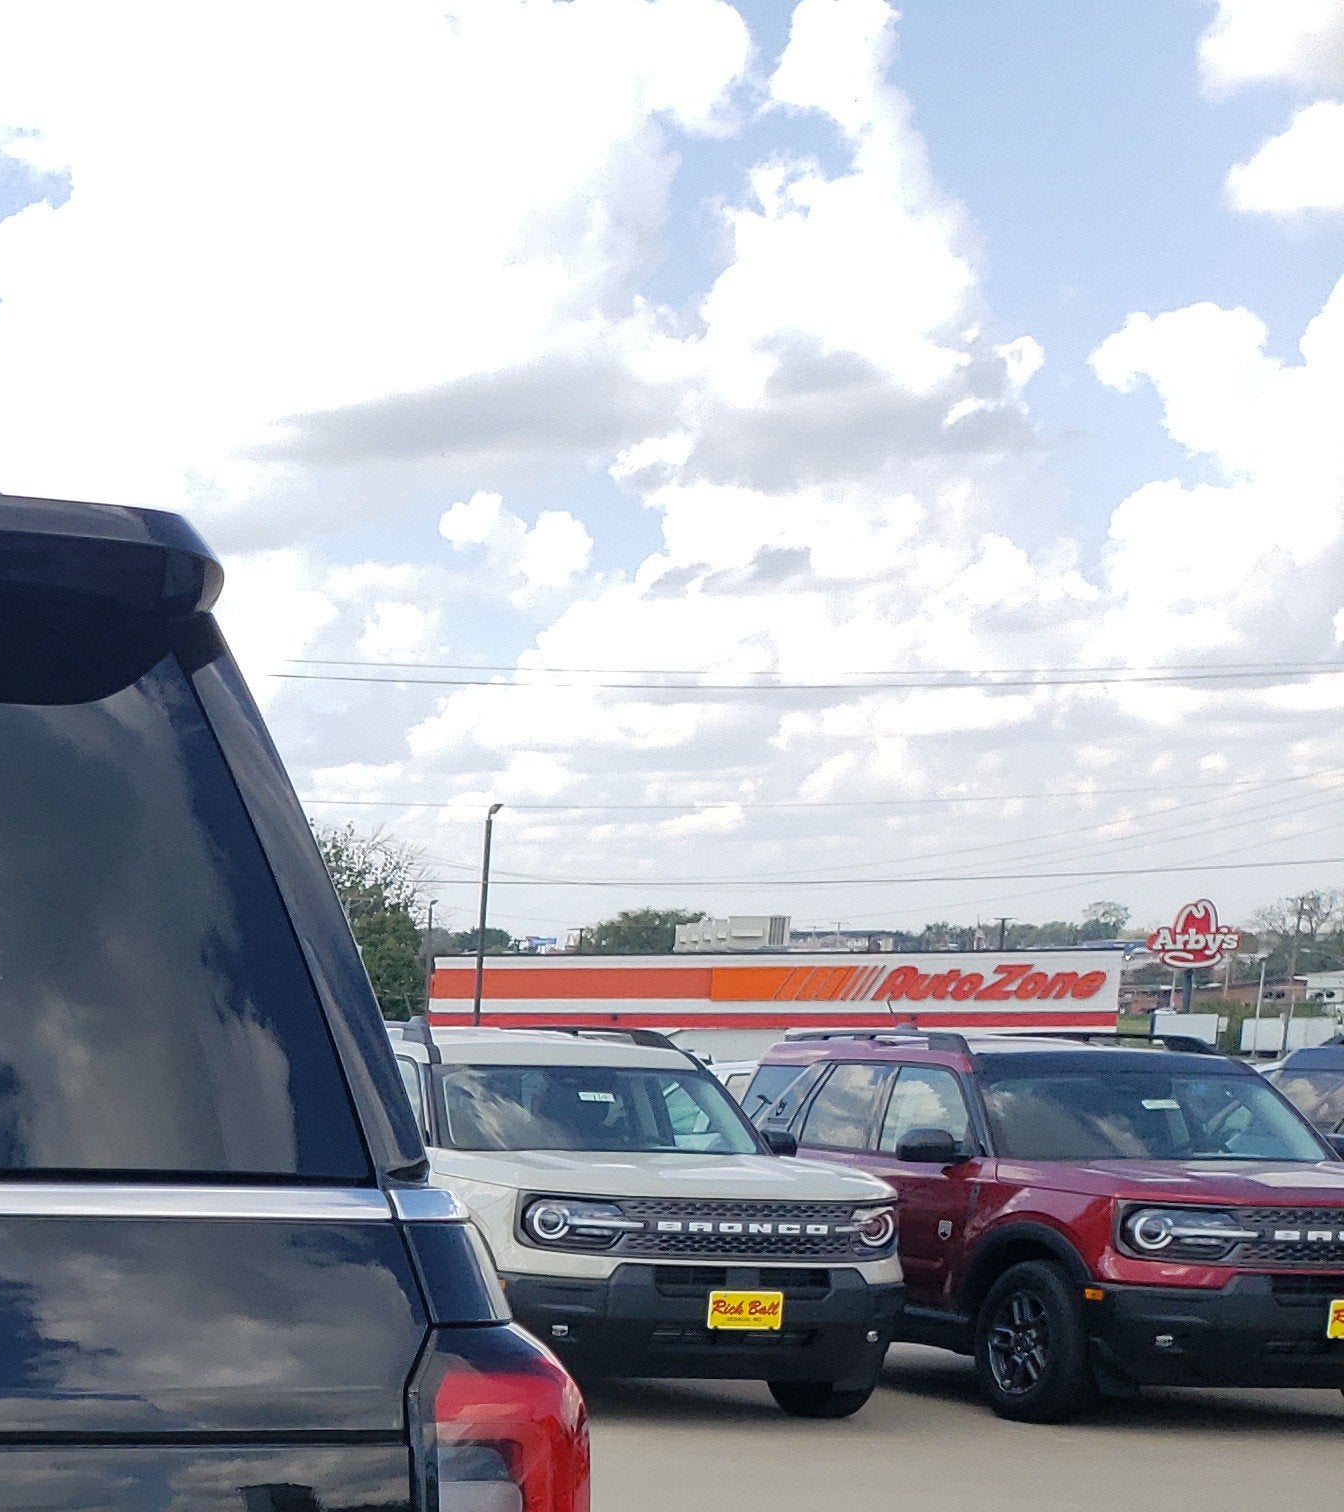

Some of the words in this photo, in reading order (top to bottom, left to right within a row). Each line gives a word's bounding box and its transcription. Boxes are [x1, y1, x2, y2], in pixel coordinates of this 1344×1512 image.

[1153, 927, 1238, 955] Arby's
[872, 963, 1107, 1001] AutoZone
[657, 1221, 829, 1235] BRONCO
[712, 1299, 744, 1315] Rick
[749, 1300, 780, 1315] Ball
